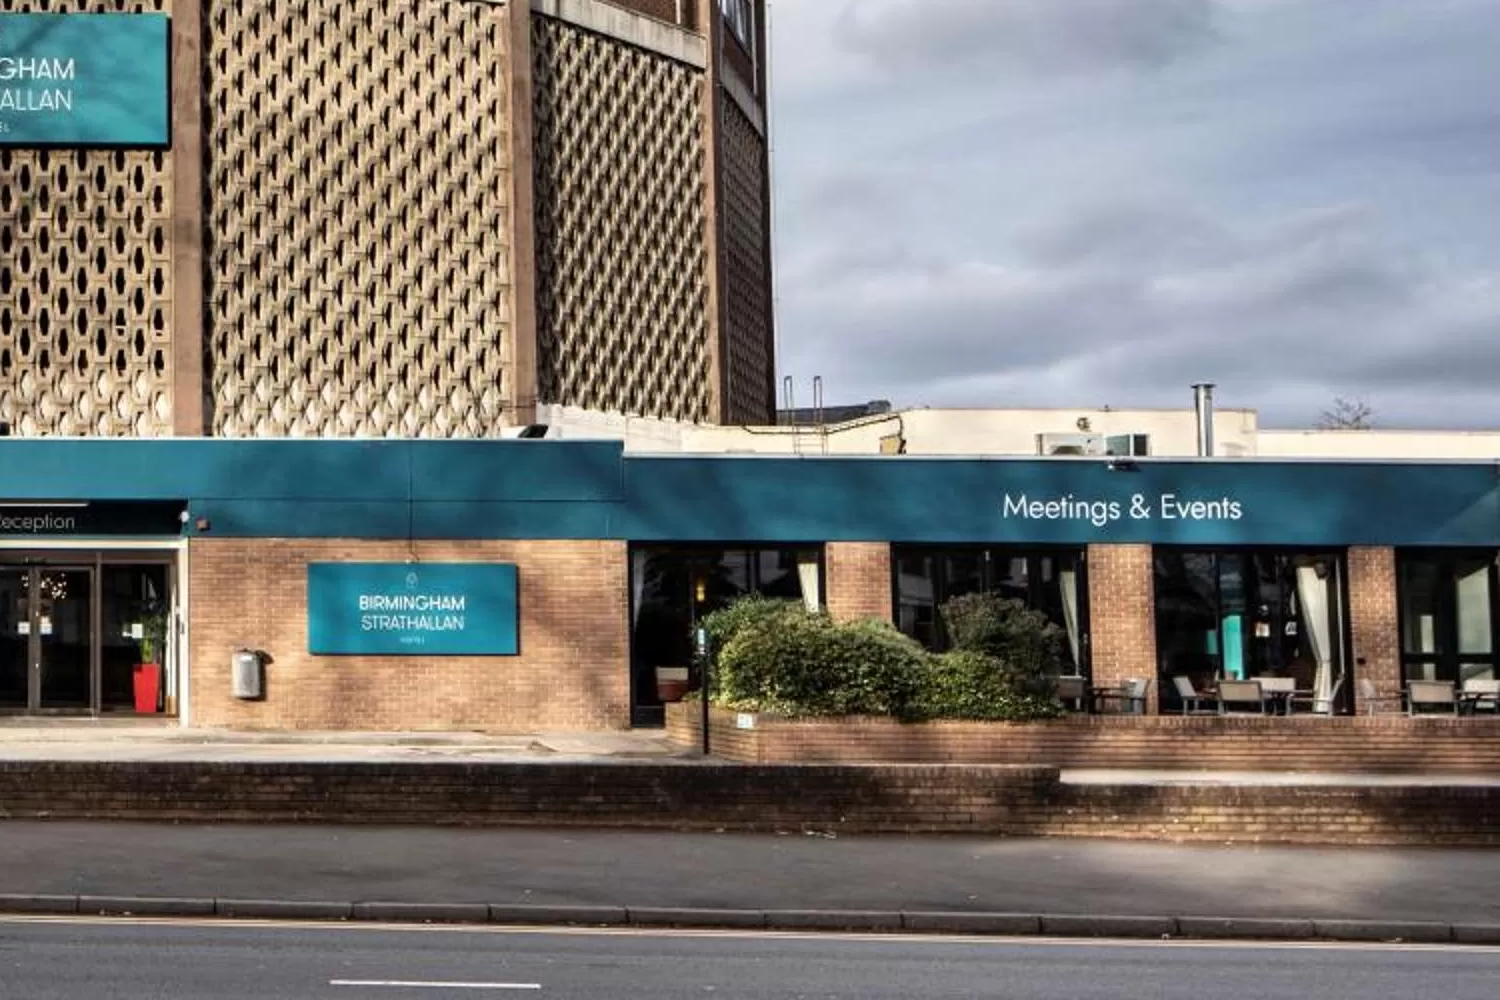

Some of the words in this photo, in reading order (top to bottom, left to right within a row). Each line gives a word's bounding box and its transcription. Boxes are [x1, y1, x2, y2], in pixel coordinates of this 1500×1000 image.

[1002, 493, 1121, 527] Meetings
[1129, 493, 1151, 520] &
[1160, 494, 1243, 520] Events
[358, 595, 466, 611] BIRMINGHAM
[361, 614, 466, 631] STRATHALLAN
